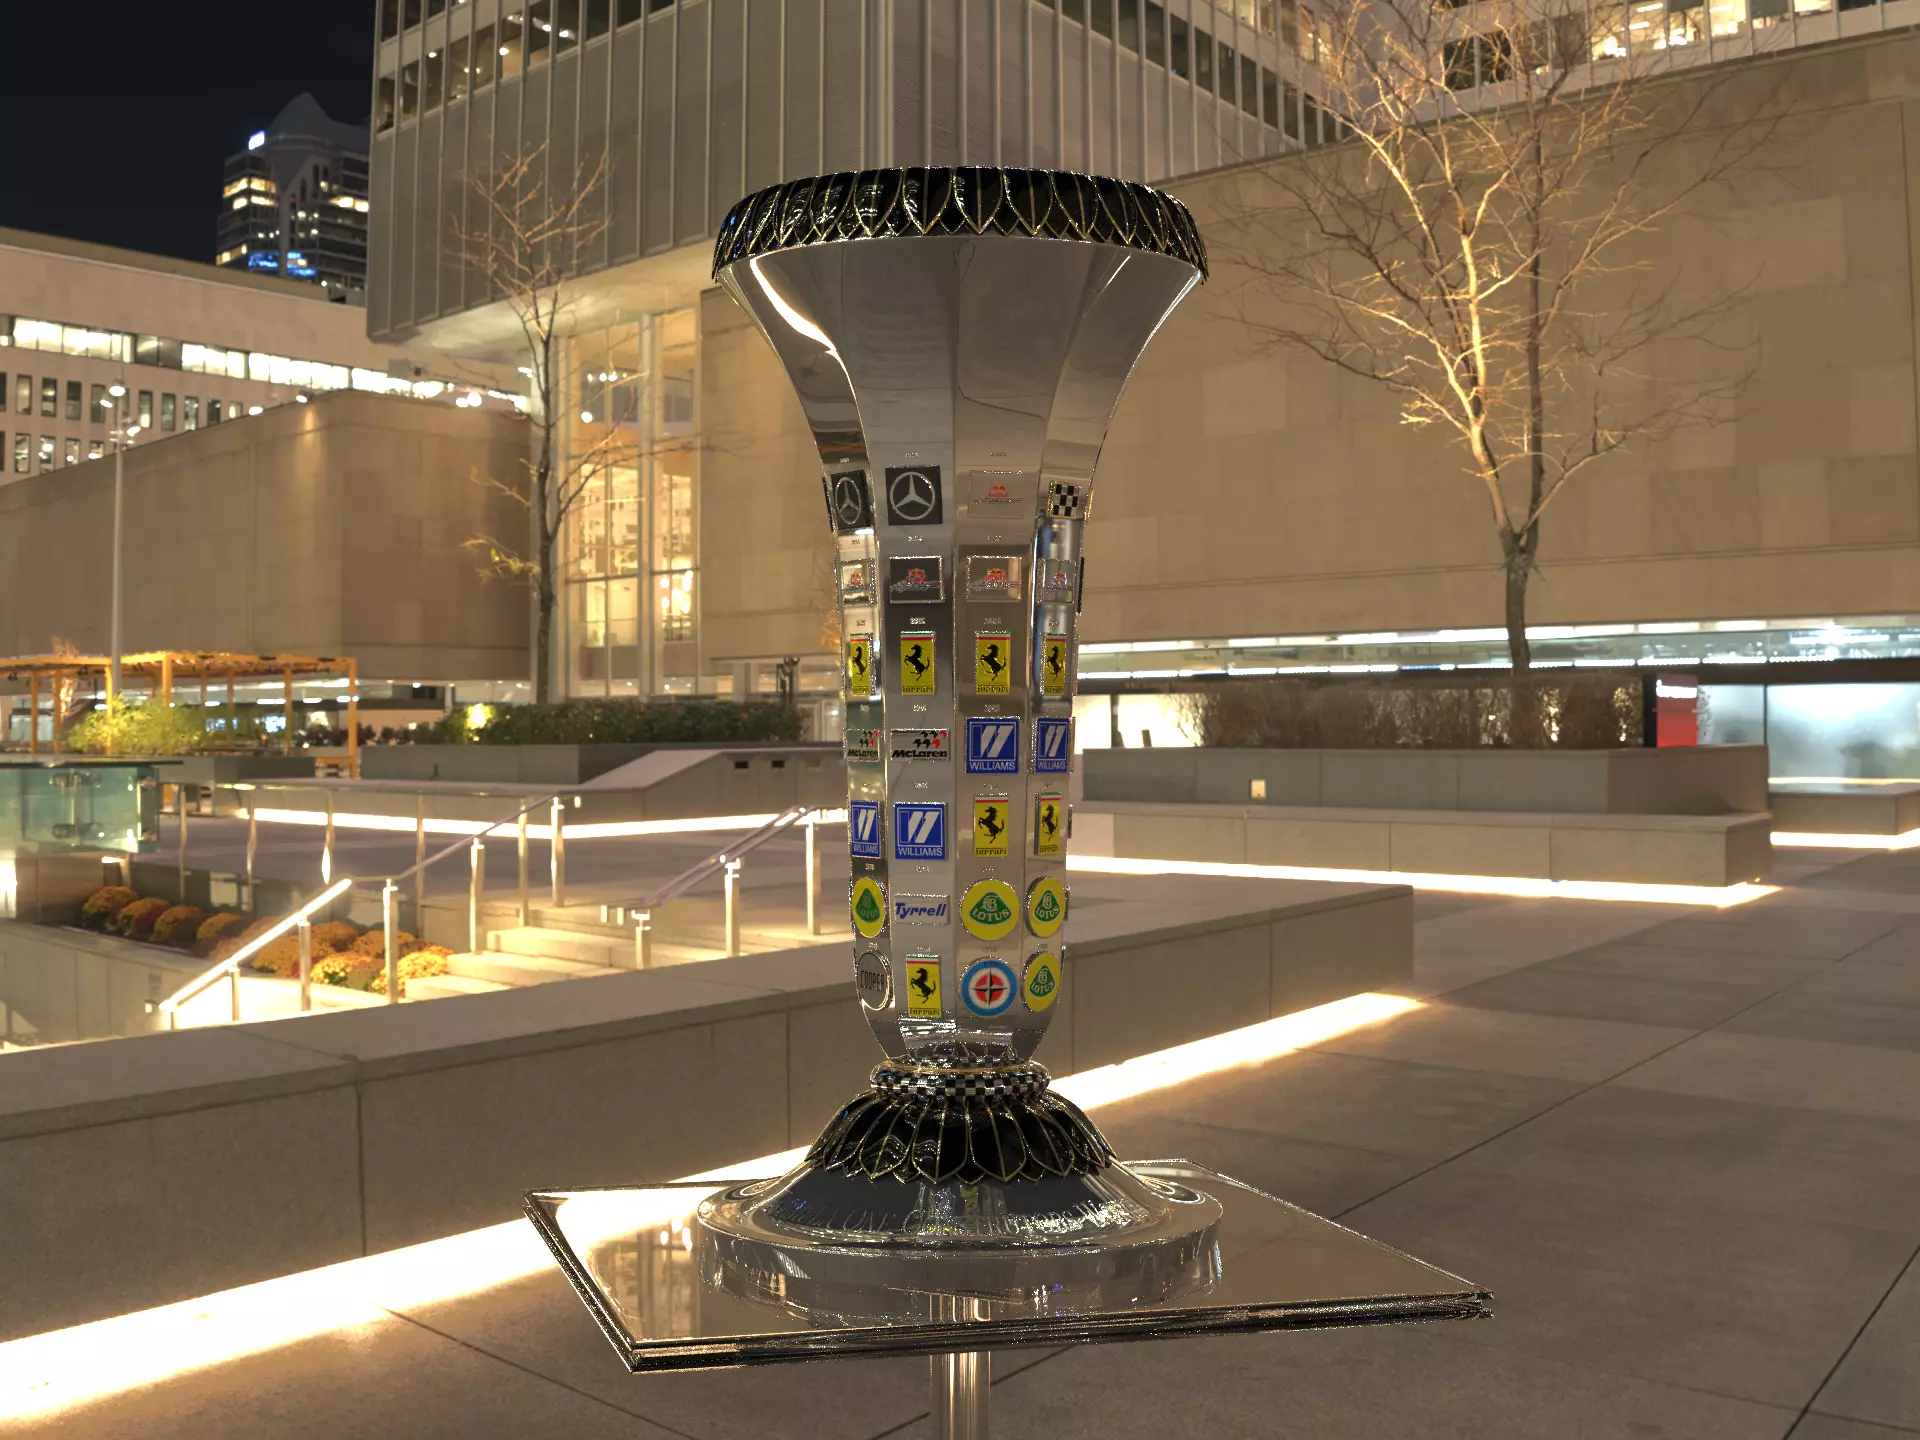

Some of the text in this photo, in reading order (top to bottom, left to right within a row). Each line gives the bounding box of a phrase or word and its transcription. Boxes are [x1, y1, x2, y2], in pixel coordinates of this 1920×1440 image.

[892, 749, 948, 758] McLaren
[969, 761, 1016, 771] WILLIAMS
[1038, 760, 1067, 770] WILLIAMS
[853, 844, 879, 854] WILLIAMS
[898, 847, 943, 857] WILLIAMS
[895, 902, 947, 919] Tyrrell
[971, 907, 1010, 922] LOTUS
[1035, 904, 1060, 920] LOTUS
[1030, 979, 1055, 994] LOTUS
